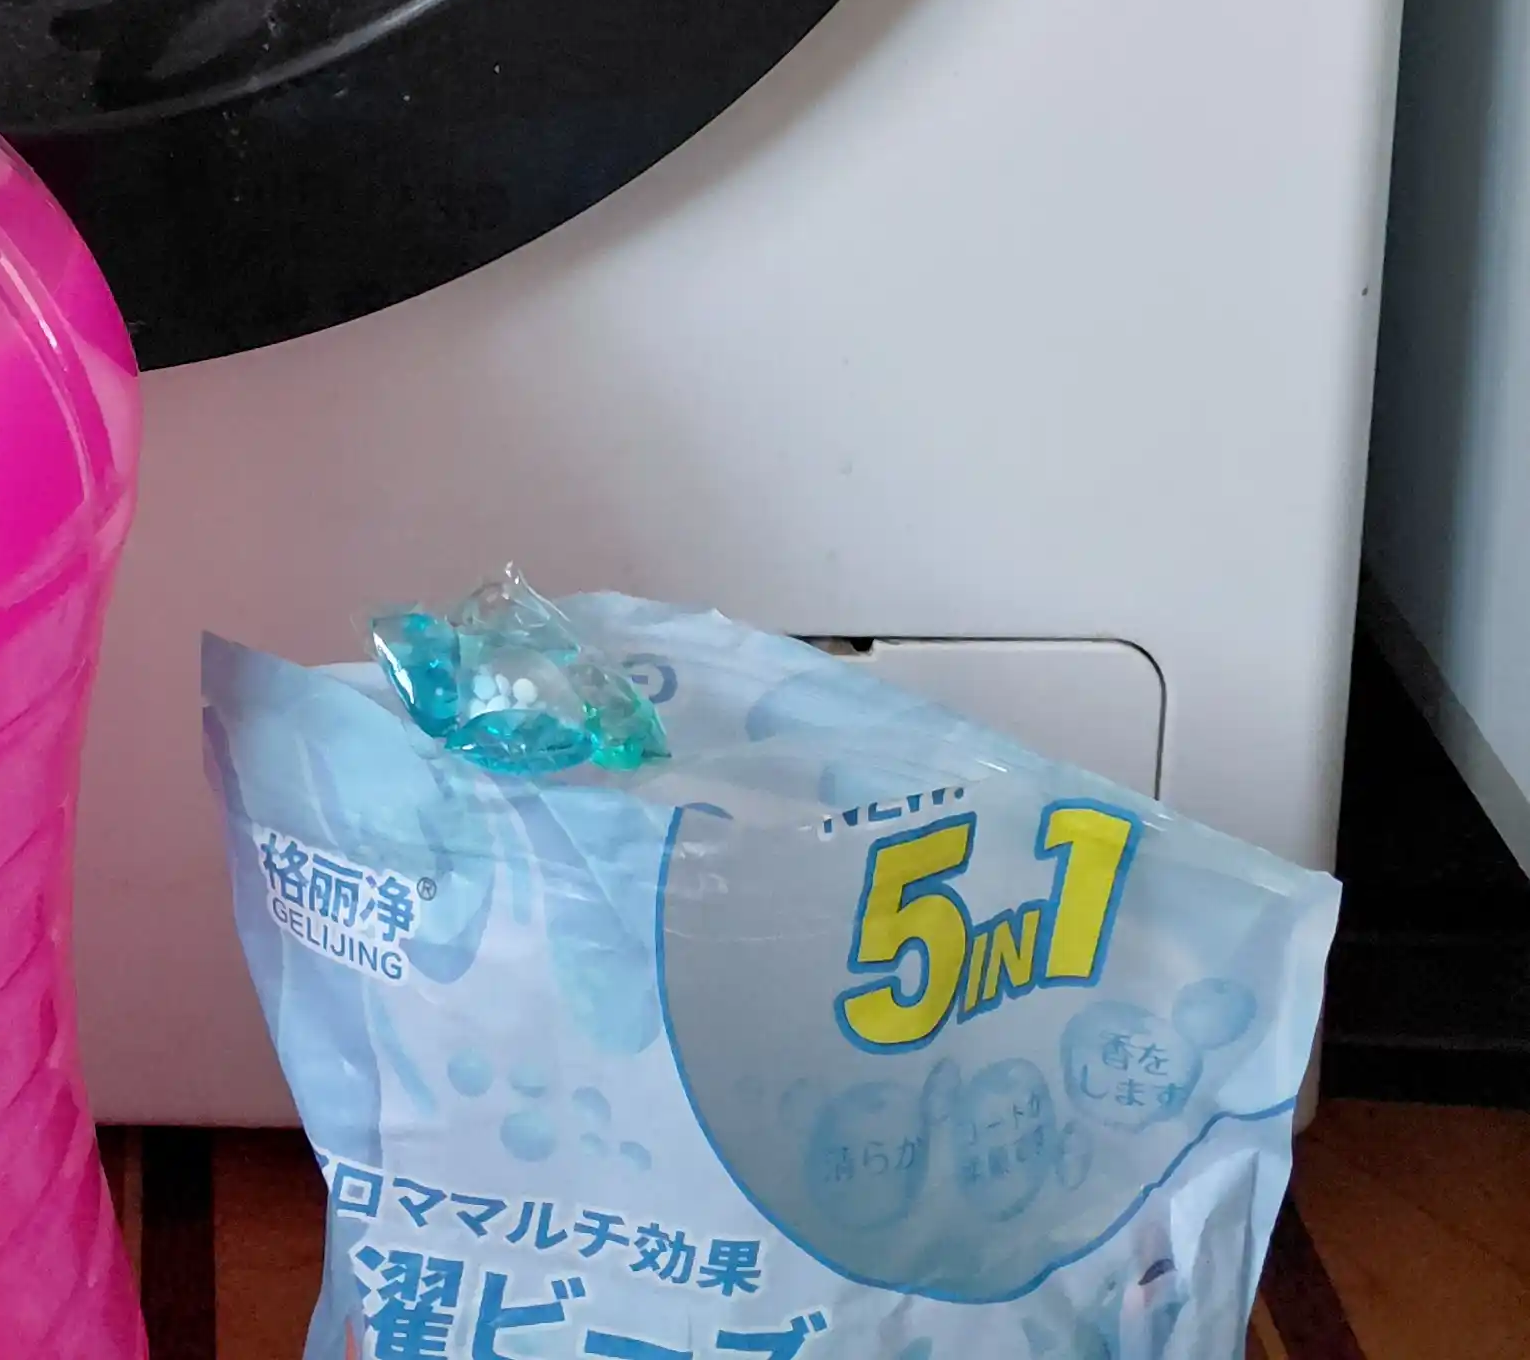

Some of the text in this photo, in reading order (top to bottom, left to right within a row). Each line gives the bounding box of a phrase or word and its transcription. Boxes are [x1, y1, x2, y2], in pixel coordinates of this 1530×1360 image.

[260, 832, 415, 943] 格丽净
[271, 896, 403, 980] GELIJING
[314, 1154, 763, 1297] ロママルチ効果
